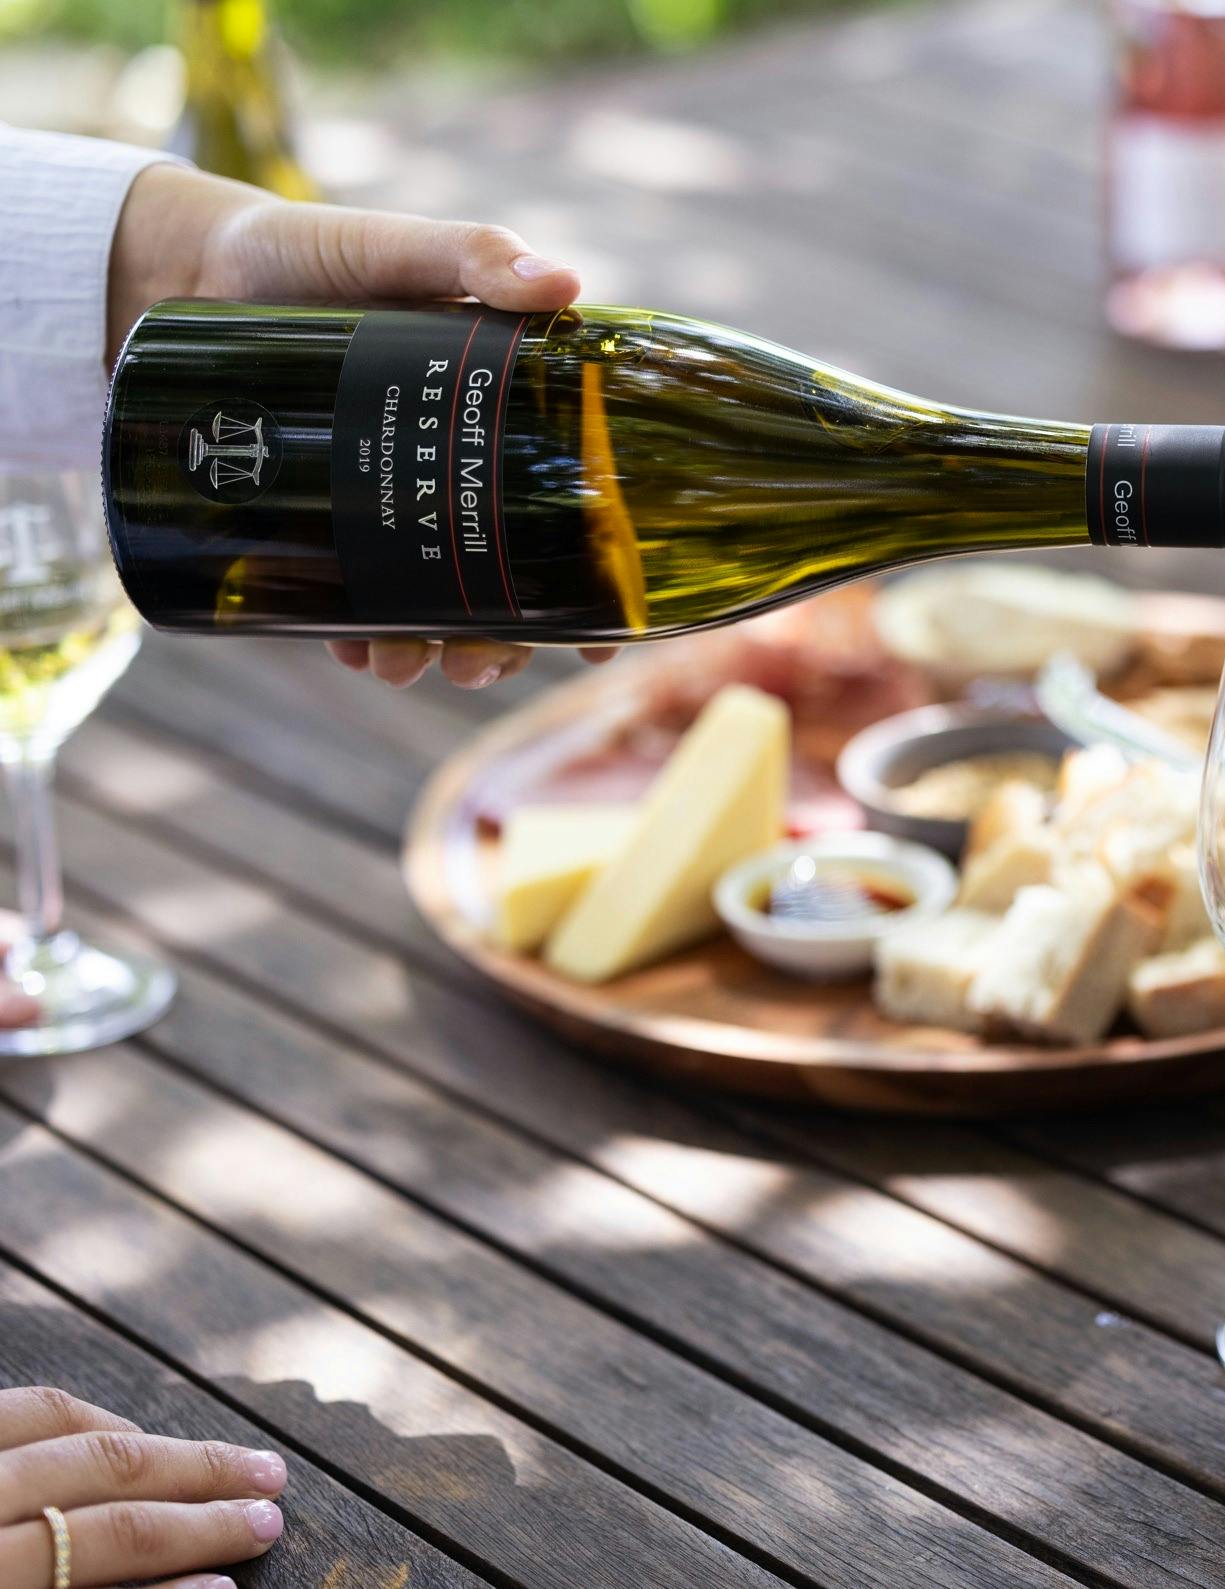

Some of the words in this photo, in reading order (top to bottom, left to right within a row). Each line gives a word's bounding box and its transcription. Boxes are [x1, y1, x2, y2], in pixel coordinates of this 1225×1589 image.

[461, 368, 493, 447] Geoff
[359, 439, 371, 473] 2019
[380, 385, 400, 530] CHARDONNAY
[416, 359, 449, 560] RESERVE
[460, 458, 488, 552] Merrill
[1114, 480, 1137, 540] Geoff
